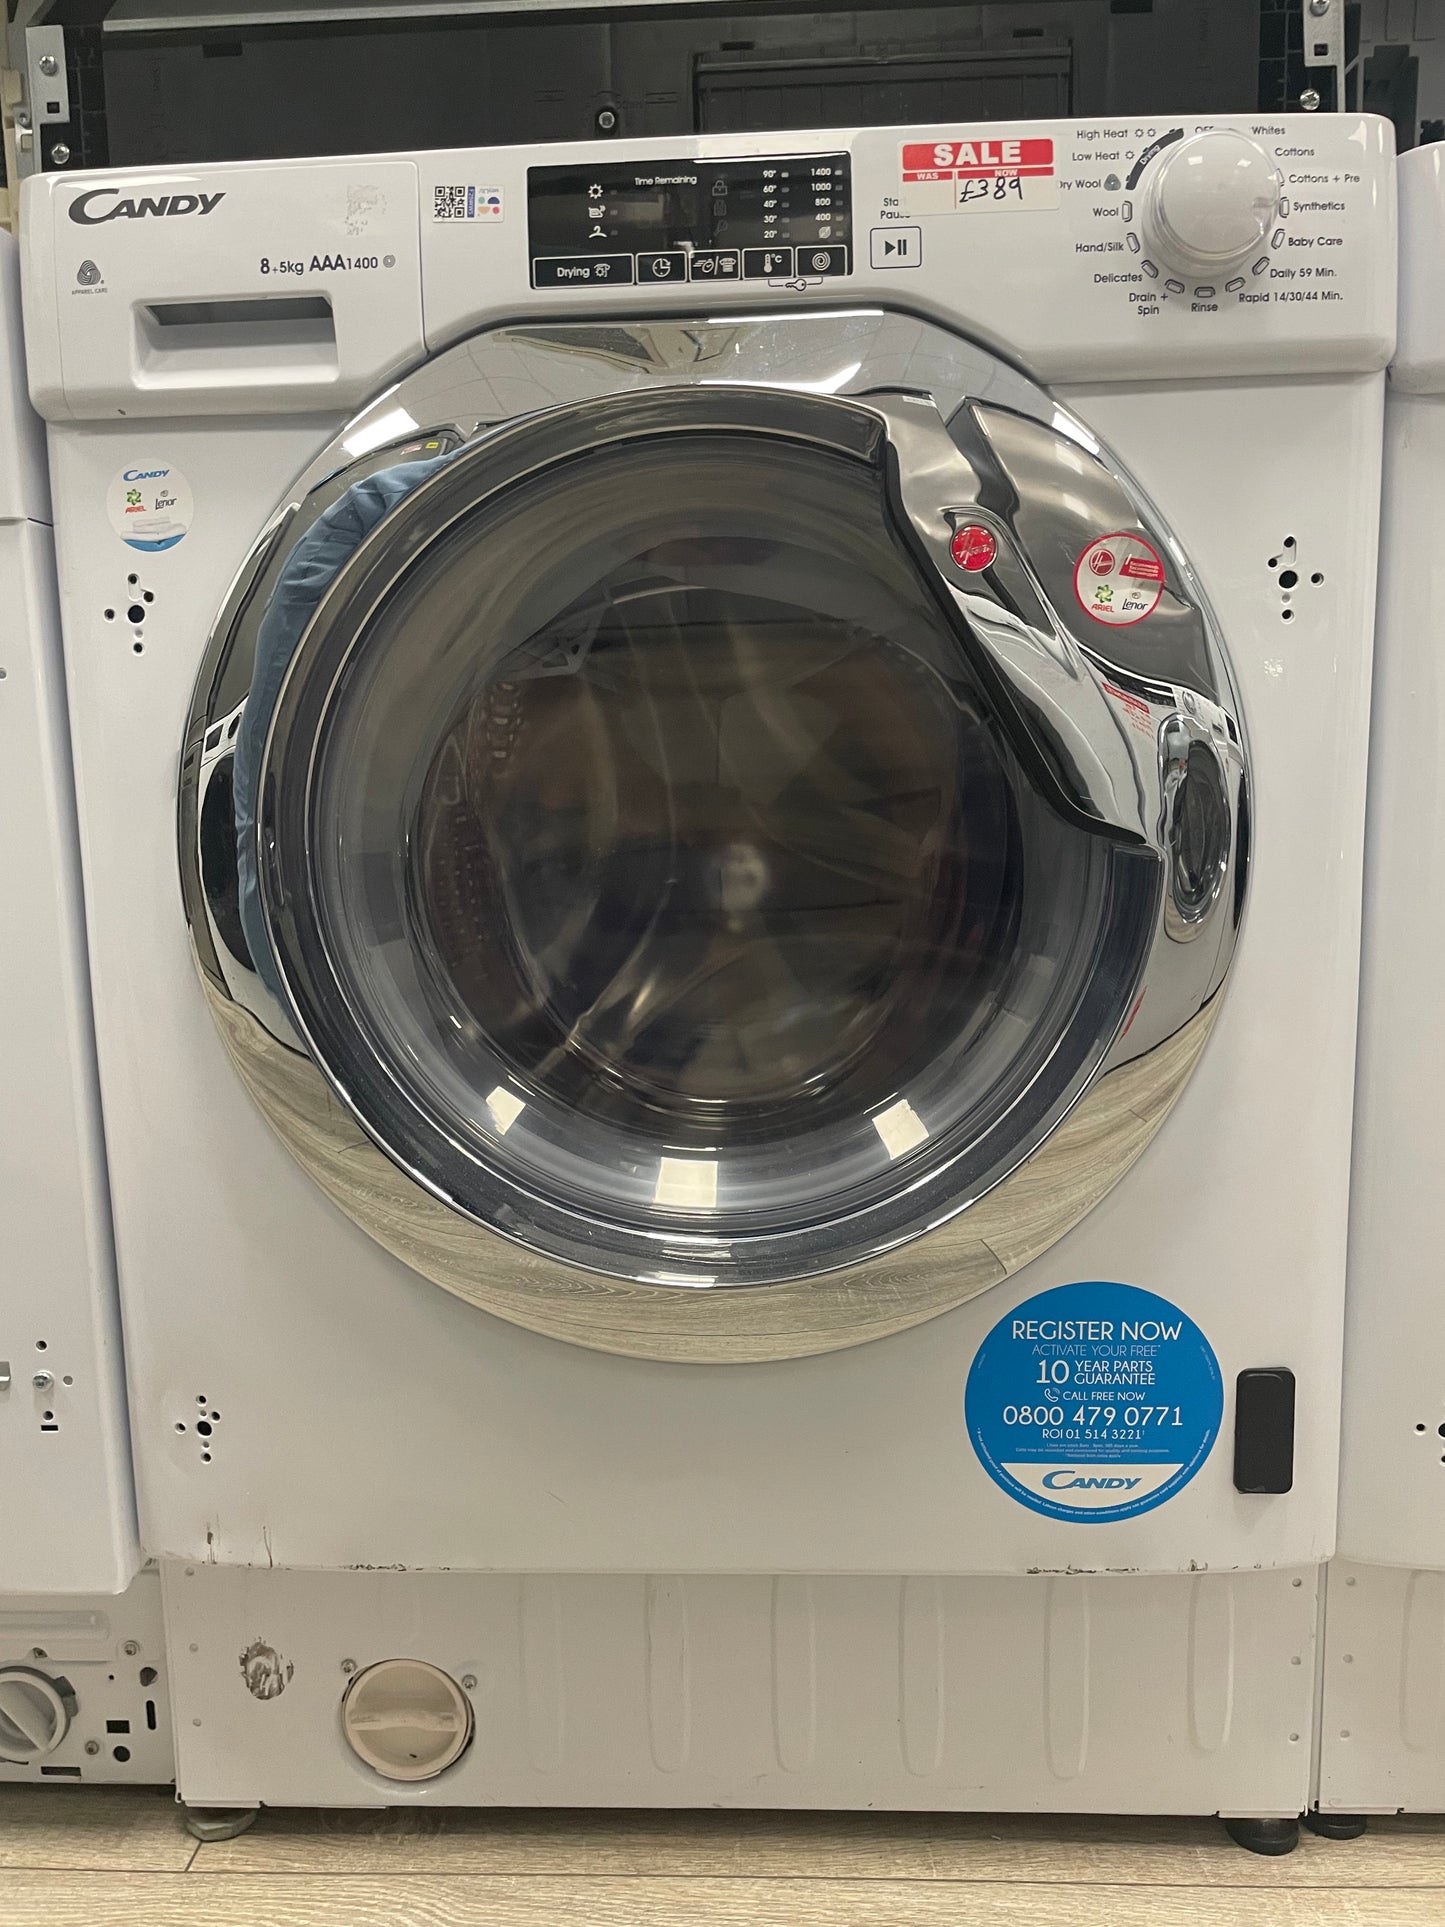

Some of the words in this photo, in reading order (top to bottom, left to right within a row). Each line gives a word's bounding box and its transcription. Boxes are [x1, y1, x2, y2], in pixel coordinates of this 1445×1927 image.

[1077, 129, 1100, 141] High
[1104, 129, 1128, 138] Heat
[1251, 126, 1286, 135] Whites
[933, 141, 1022, 167] SALE
[1072, 152, 1092, 161] Low
[1095, 151, 1120, 160] Heat
[1275, 147, 1315, 156] Cottons
[762, 170, 777, 178] 90°
[810, 168, 832, 176] 1400
[916, 172, 939, 181] WAS
[994, 169, 1018, 178] NOW
[634, 177, 653, 186] Time
[655, 176, 697, 186] Remaining
[1288, 174, 1329, 183] Cottons
[1344, 173, 1360, 183] Pre
[762, 184, 777, 193] 60°
[810, 182, 832, 191] 1000
[959, 176, 1023, 203] £389
[1075, 179, 1102, 189] Wool
[68, 188, 227, 225] CANDY
[763, 199, 778, 208] 40°
[814, 197, 832, 206] 800
[1293, 201, 1345, 213] Synthetics
[815, 213, 832, 221] 400
[1092, 207, 1119, 217] Wool
[763, 215, 778, 223] 30°
[763, 230, 778, 239] 20°
[1075, 242, 1124, 253] Hand/Silk
[1288, 237, 1314, 248] Baby
[1317, 236, 1343, 246] Care
[556, 266, 590, 278] Drying
[1093, 272, 1143, 283] Delicates
[1270, 268, 1296, 279] Daily
[1299, 267, 1312, 277] 59
[1315, 267, 1337, 277] Min.
[1128, 292, 1157, 302] Drain
[1238, 292, 1270, 304] Rapid
[1274, 291, 1318, 302] 14/30/44
[1321, 291, 1343, 301] Min.
[1137, 305, 1160, 316] Spin
[1191, 302, 1218, 312] Rinse
[123, 469, 170, 482] CANDY
[155, 498, 177, 510] Lenor
[1090, 603, 1115, 613] ARIEL
[1122, 598, 1149, 611] Lenor
[1012, 1320, 1114, 1340] REGISTER
[1121, 1321, 1183, 1341] NOW
[1032, 1344, 1087, 1356] ACTIVATE
[1091, 1344, 1128, 1357] YOUR
[1036, 1359, 1070, 1384] 10
[1075, 1360, 1110, 1372] YEAR
[1113, 1360, 1153, 1373] PARTS
[1074, 1372, 1156, 1385] GUARANTEE
[1063, 1391, 1088, 1401] CALL
[1091, 1391, 1116, 1401] FREE
[1117, 1391, 1146, 1402] NOW
[1003, 1405, 1064, 1426] 0800
[1072, 1404, 1117, 1426] 479
[1124, 1406, 1184, 1427] 0771
[1042, 1428, 1063, 1439] ROI
[1066, 1428, 1081, 1440] 01
[1085, 1428, 1107, 1440] 514
[1042, 1470, 1143, 1490] CANDY
